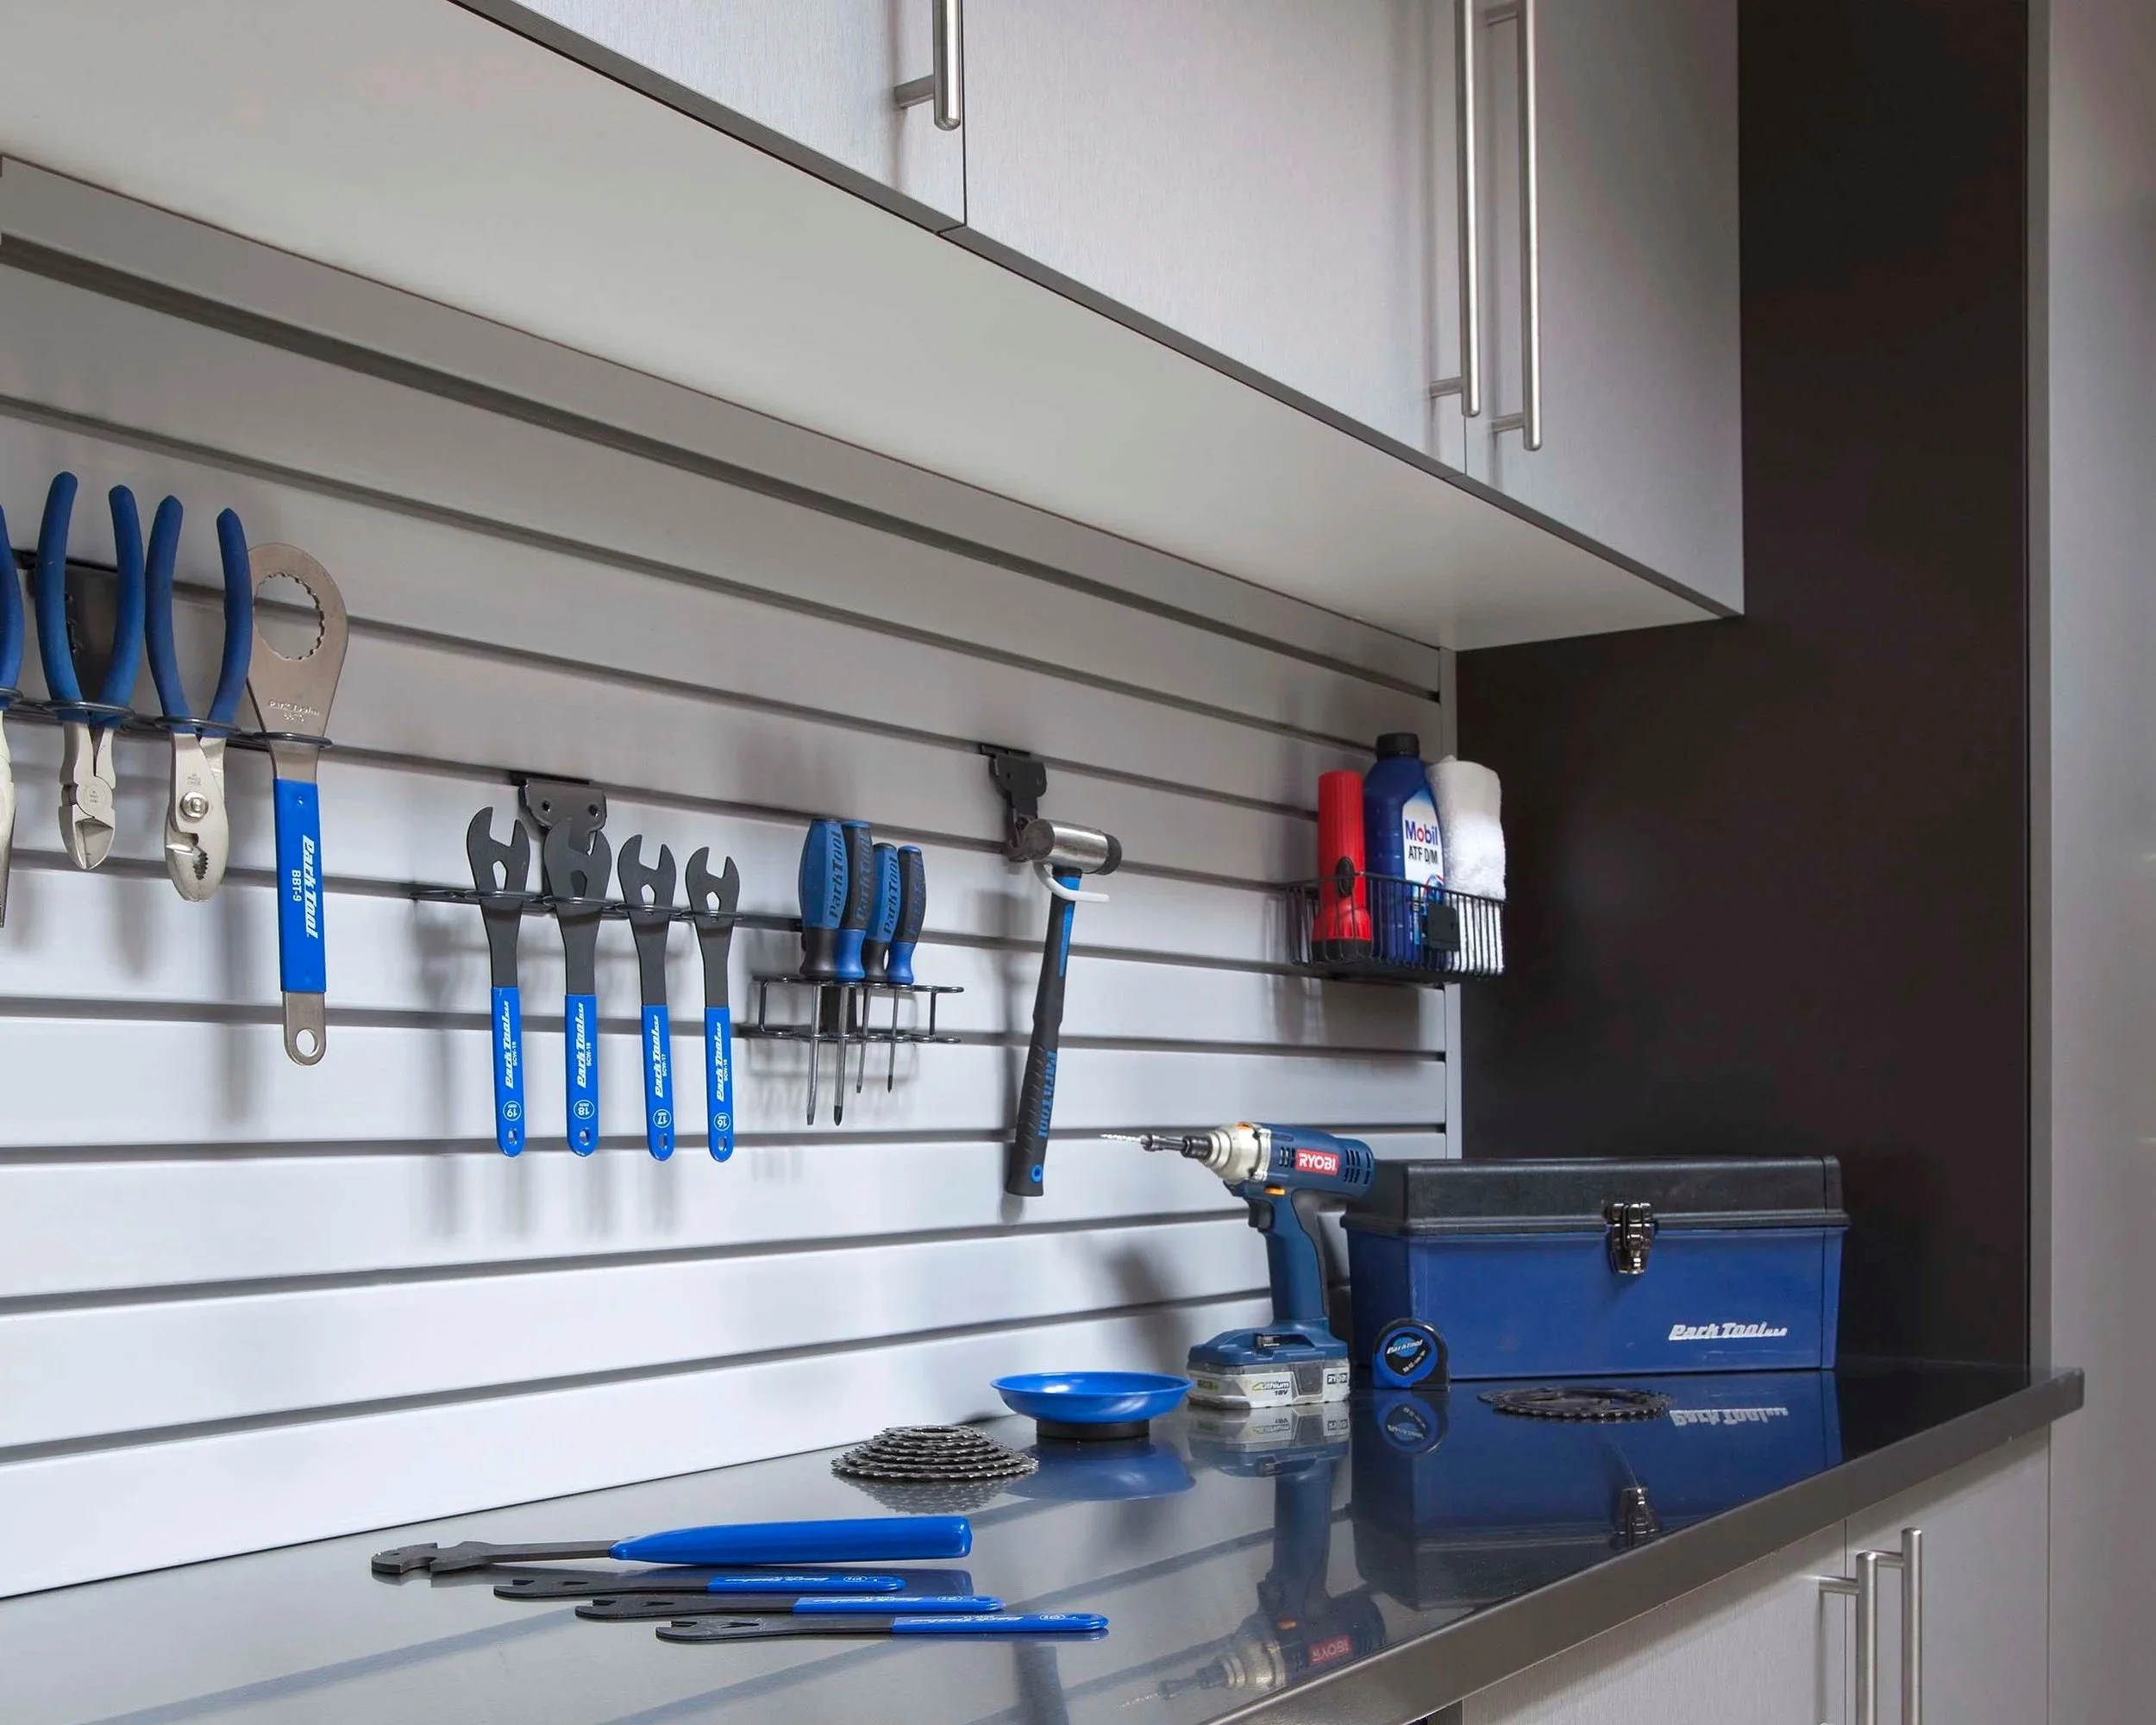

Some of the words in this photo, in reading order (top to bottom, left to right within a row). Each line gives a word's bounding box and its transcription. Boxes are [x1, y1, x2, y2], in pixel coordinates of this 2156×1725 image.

[1405, 819, 1438, 846] Mobil
[1408, 844, 1423, 862] ATF
[1424, 849, 1438, 865] D/M
[291, 869, 302, 902] BBT-9
[506, 1107, 518, 1118] 19
[578, 1107, 590, 1116] 18
[657, 1116, 667, 1125] 17
[717, 1119, 728, 1128] 16
[1299, 1152, 1336, 1171] RYOBI
[1668, 1323, 1720, 1341] Park
[1721, 1321, 1767, 1339] Tool
